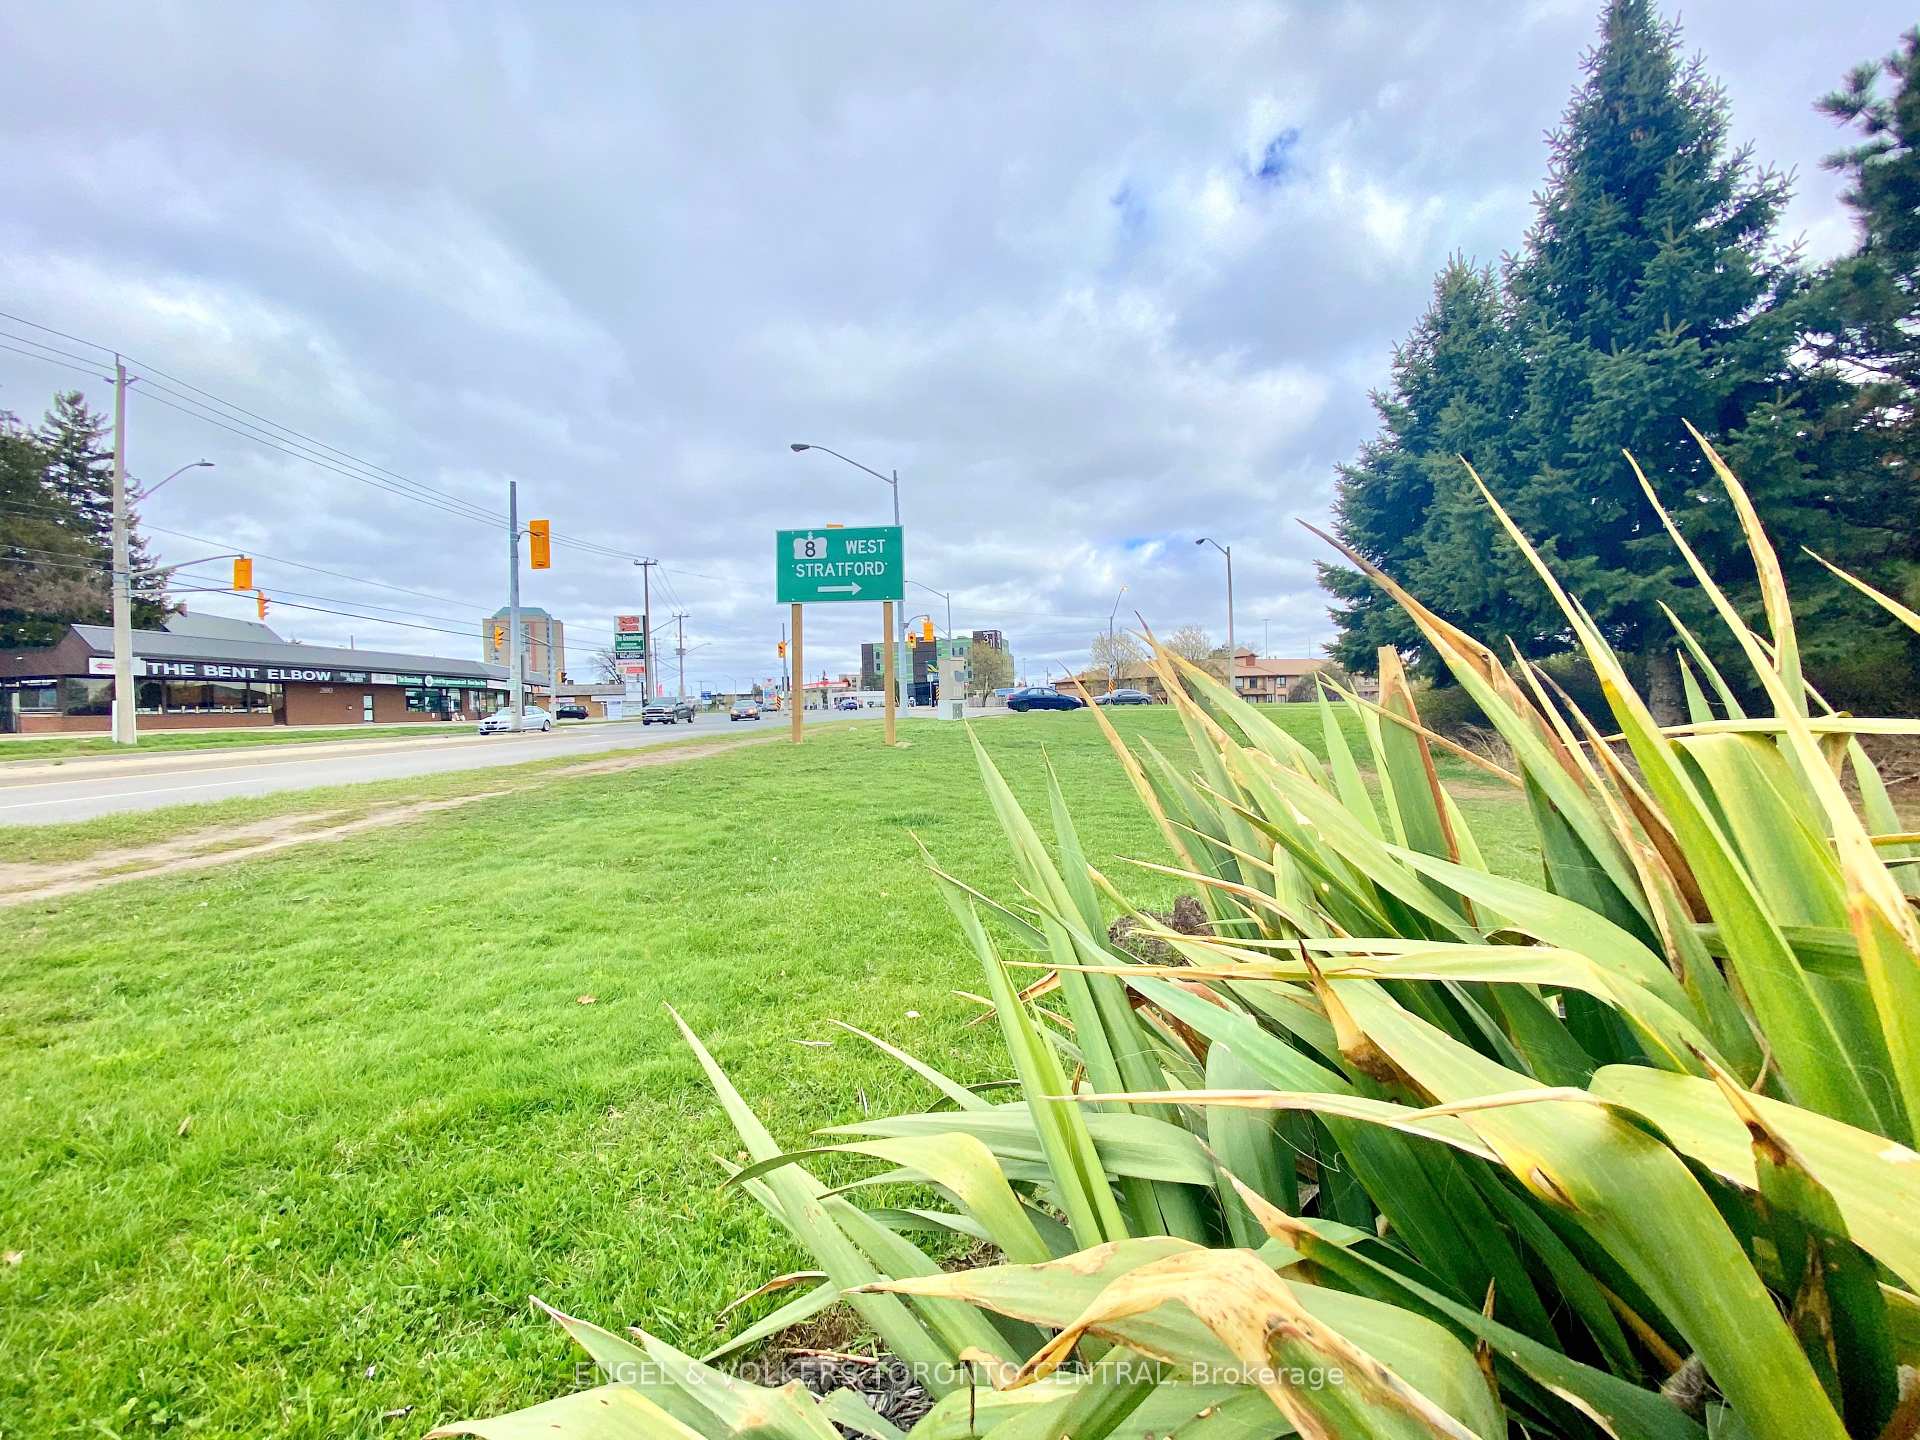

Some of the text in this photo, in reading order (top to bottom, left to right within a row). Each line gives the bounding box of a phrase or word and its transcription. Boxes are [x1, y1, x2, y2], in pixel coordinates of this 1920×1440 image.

[805, 539, 886, 558] 8 WEST
[795, 561, 885, 578] STRATFORD
[147, 662, 196, 676] THE
[203, 665, 259, 679] BENT
[267, 668, 331, 681] ELBOW
